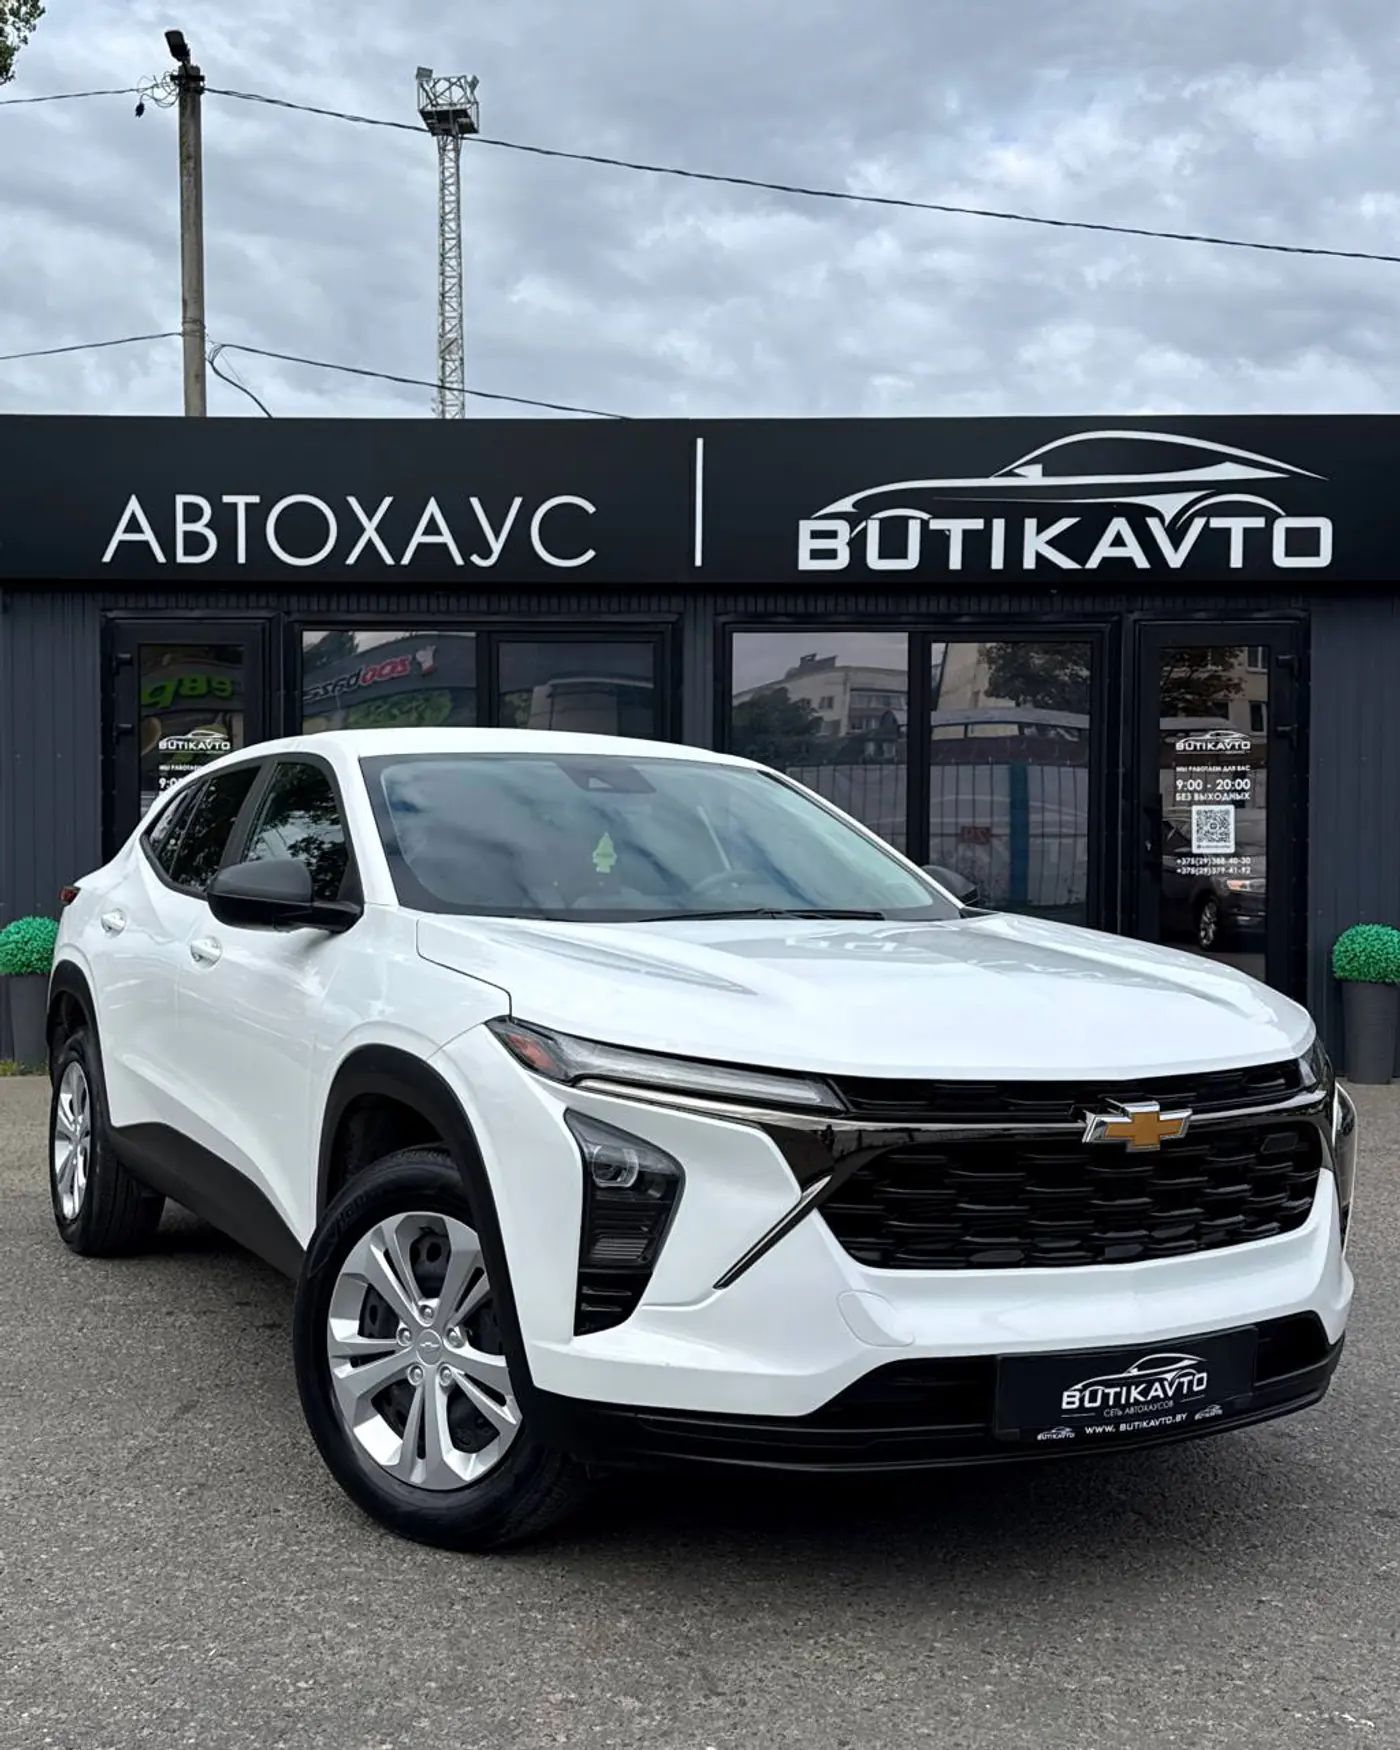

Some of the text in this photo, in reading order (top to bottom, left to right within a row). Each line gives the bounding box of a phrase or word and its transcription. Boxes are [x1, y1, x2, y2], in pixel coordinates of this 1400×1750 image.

[102, 494, 597, 568] АВТОХАУС
[798, 514, 1333, 571] BUTIKAVTO
[158, 740, 231, 751] BUTIKAVTO
[1175, 740, 1251, 751] BUTIKAVTO
[1176, 779, 1203, 790] 9:00
[1215, 779, 1251, 790] 20:00
[1175, 791, 1251, 801] БЕЗ ВЫХОДНЫХ
[1061, 1372, 1208, 1410] BUTIKAVTO
[1103, 1400, 1174, 1417] СЕТЬ АВТОХАУСОВ
[1085, 1412, 1188, 1434] WWW. BUTIKAVTO.BY
